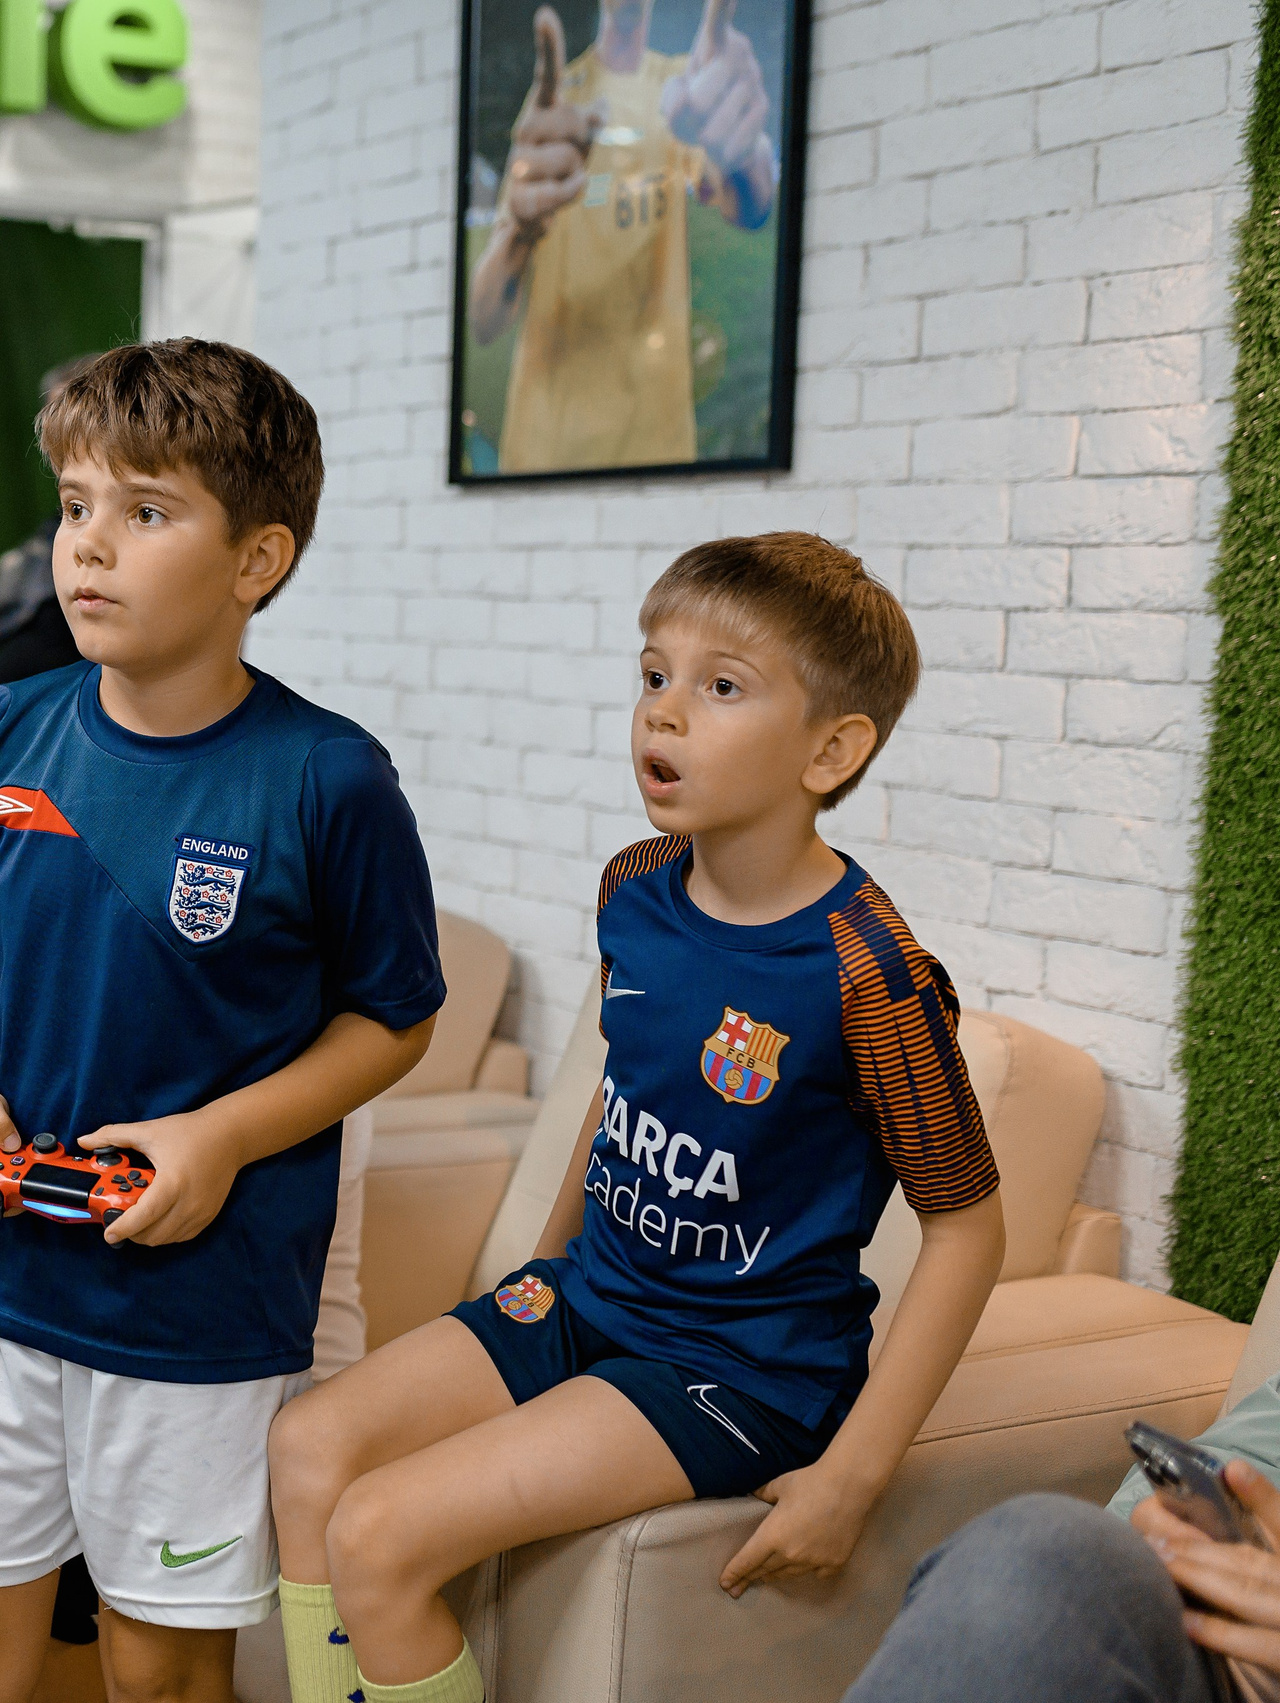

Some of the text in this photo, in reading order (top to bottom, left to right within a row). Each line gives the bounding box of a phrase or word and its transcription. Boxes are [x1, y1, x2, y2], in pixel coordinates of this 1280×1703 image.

[181, 837, 249, 860] ENGLAND
[726, 1047, 756, 1069] FCB
[584, 1127, 770, 1275] cademy
[517, 1293, 535, 1308] FCB
